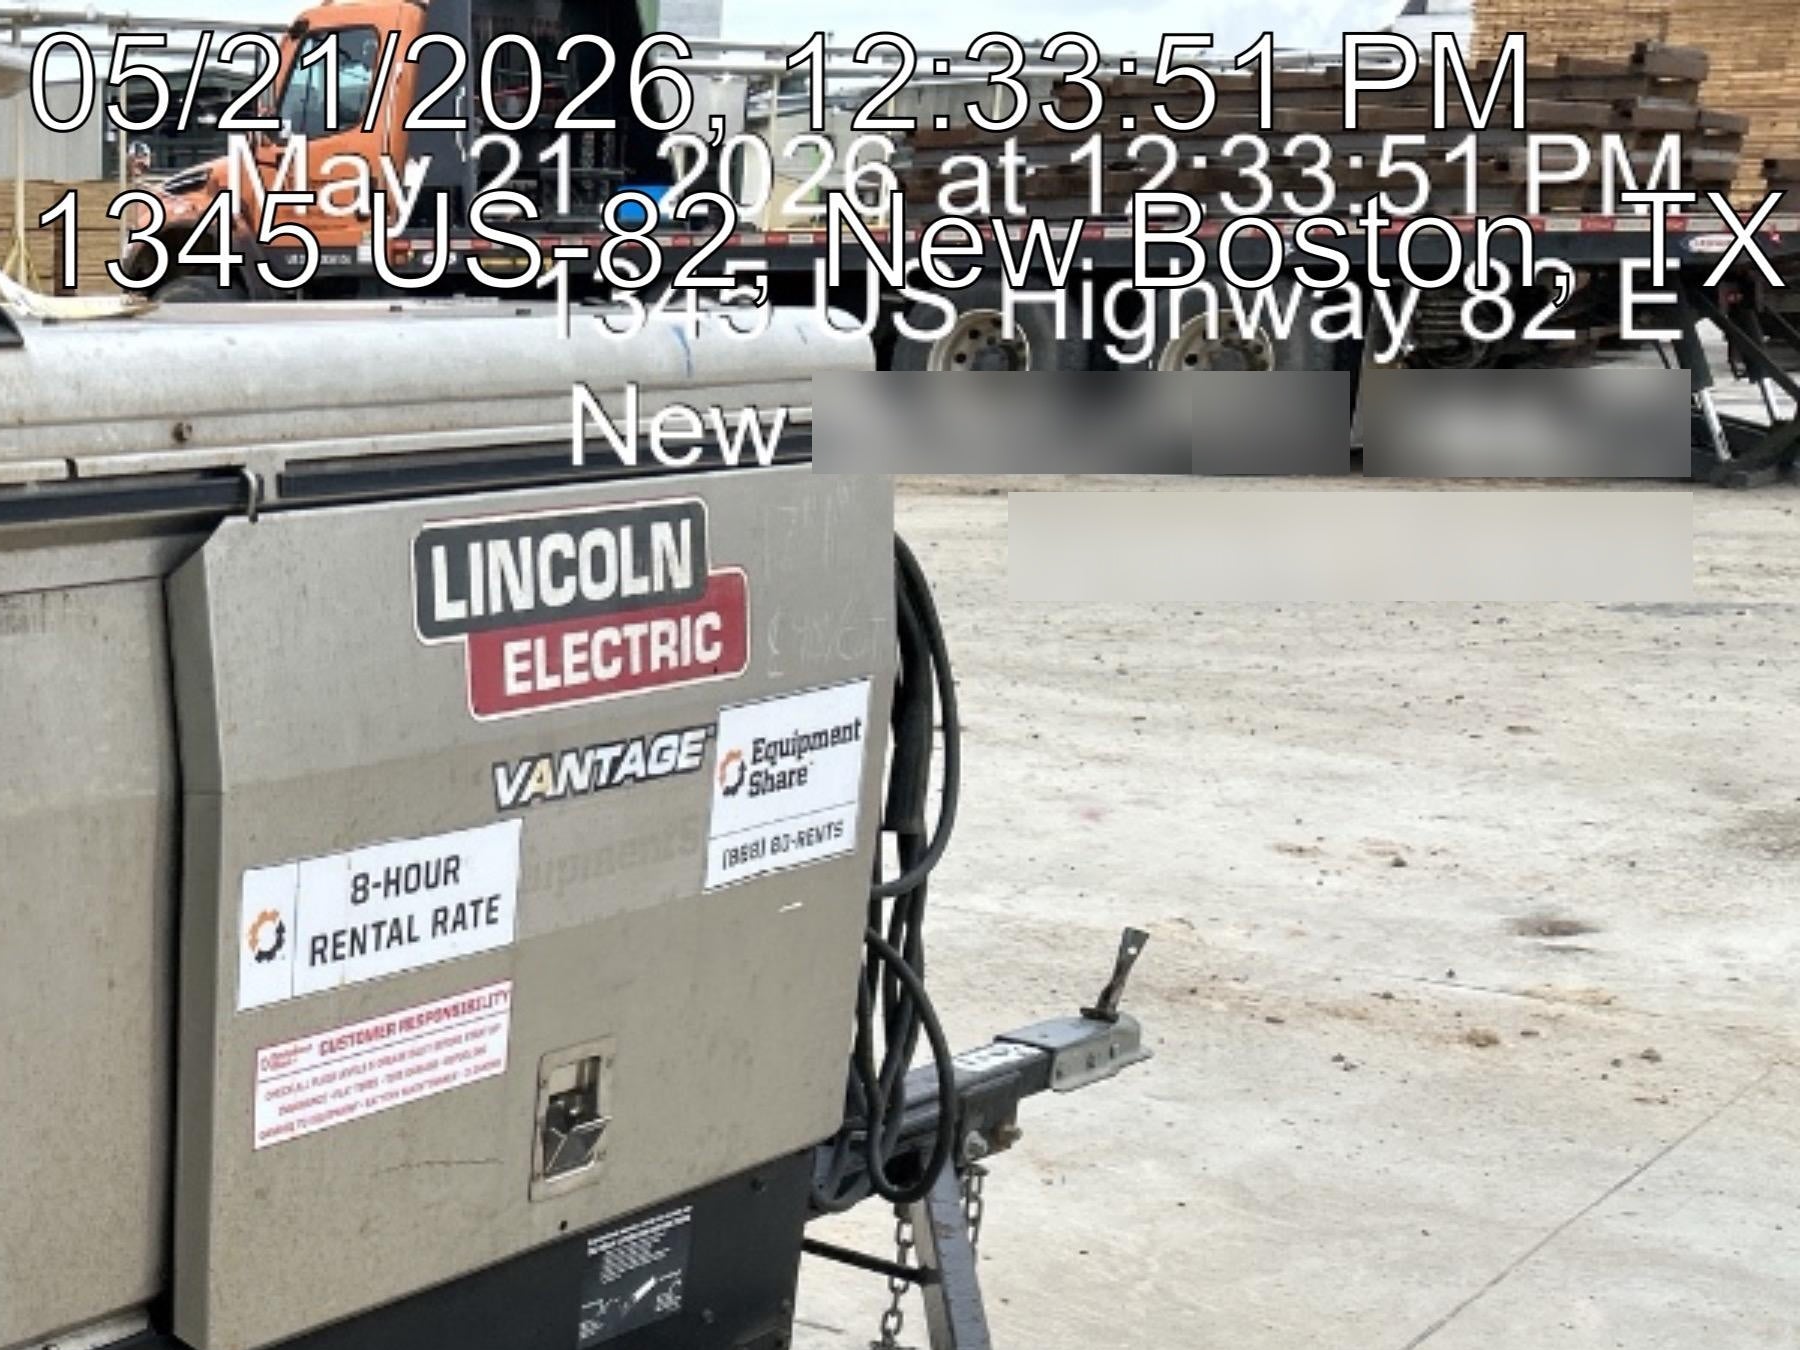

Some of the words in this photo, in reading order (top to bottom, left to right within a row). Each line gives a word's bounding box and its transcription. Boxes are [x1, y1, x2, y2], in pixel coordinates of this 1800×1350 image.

[431, 517, 694, 623] LINCOLN
[503, 611, 723, 698] ELECTRIC
[493, 725, 708, 812] VANTAGE
[751, 716, 862, 766] Equipment
[748, 766, 809, 798] Share
[350, 853, 461, 907] 8-HOUR
[308, 913, 422, 968] RENTAL
[431, 892, 503, 939] RATE
